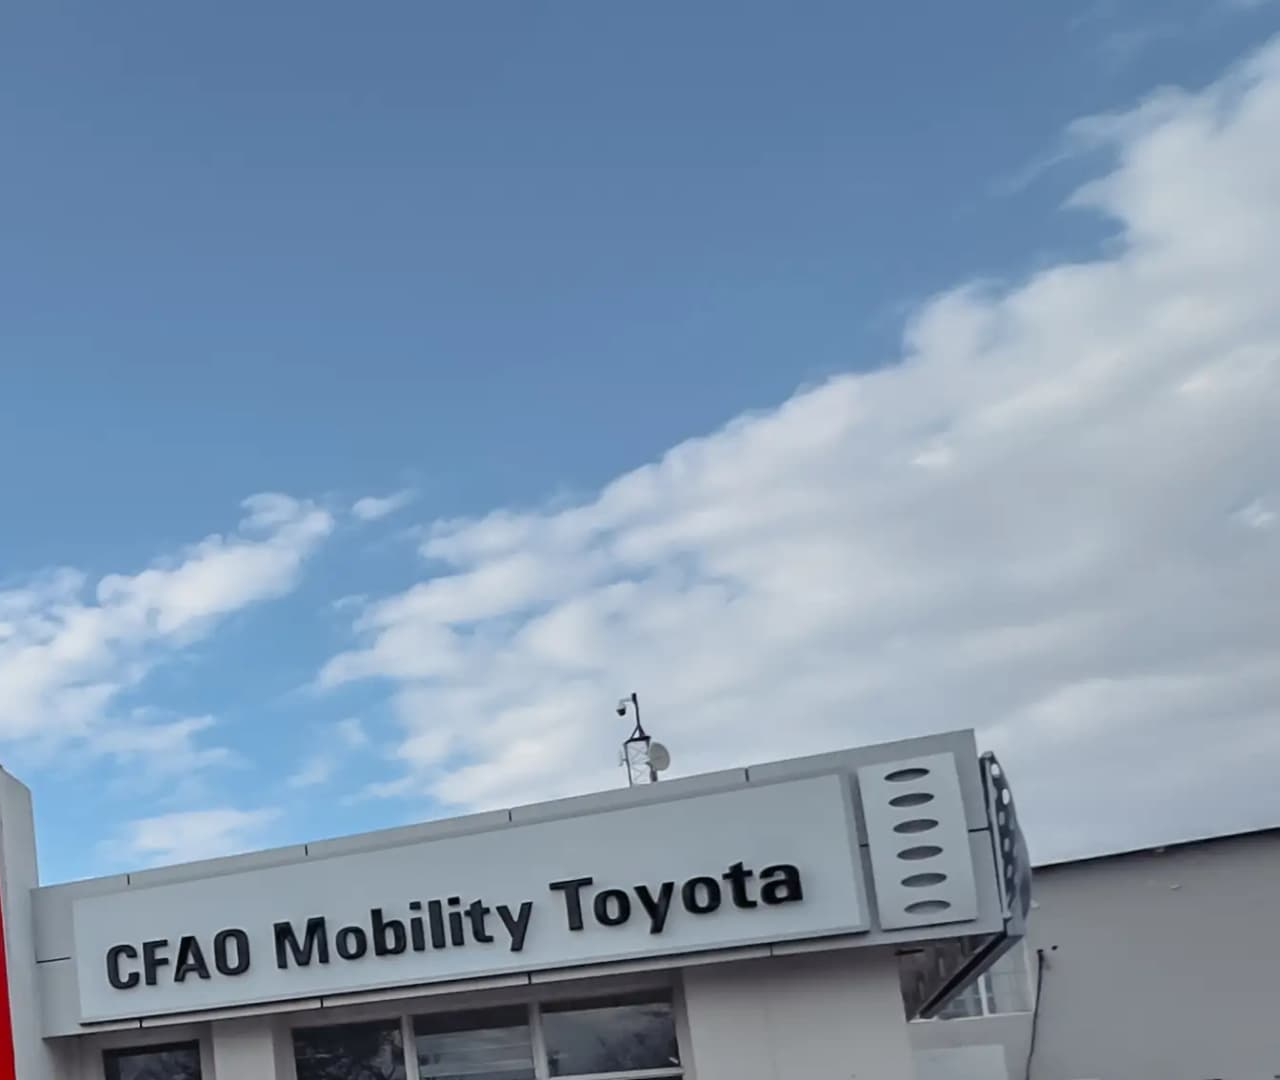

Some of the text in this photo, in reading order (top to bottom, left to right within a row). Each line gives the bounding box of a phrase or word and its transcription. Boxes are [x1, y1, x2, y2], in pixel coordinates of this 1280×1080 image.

[106, 861, 804, 990] CFAO Mobility Toyota
